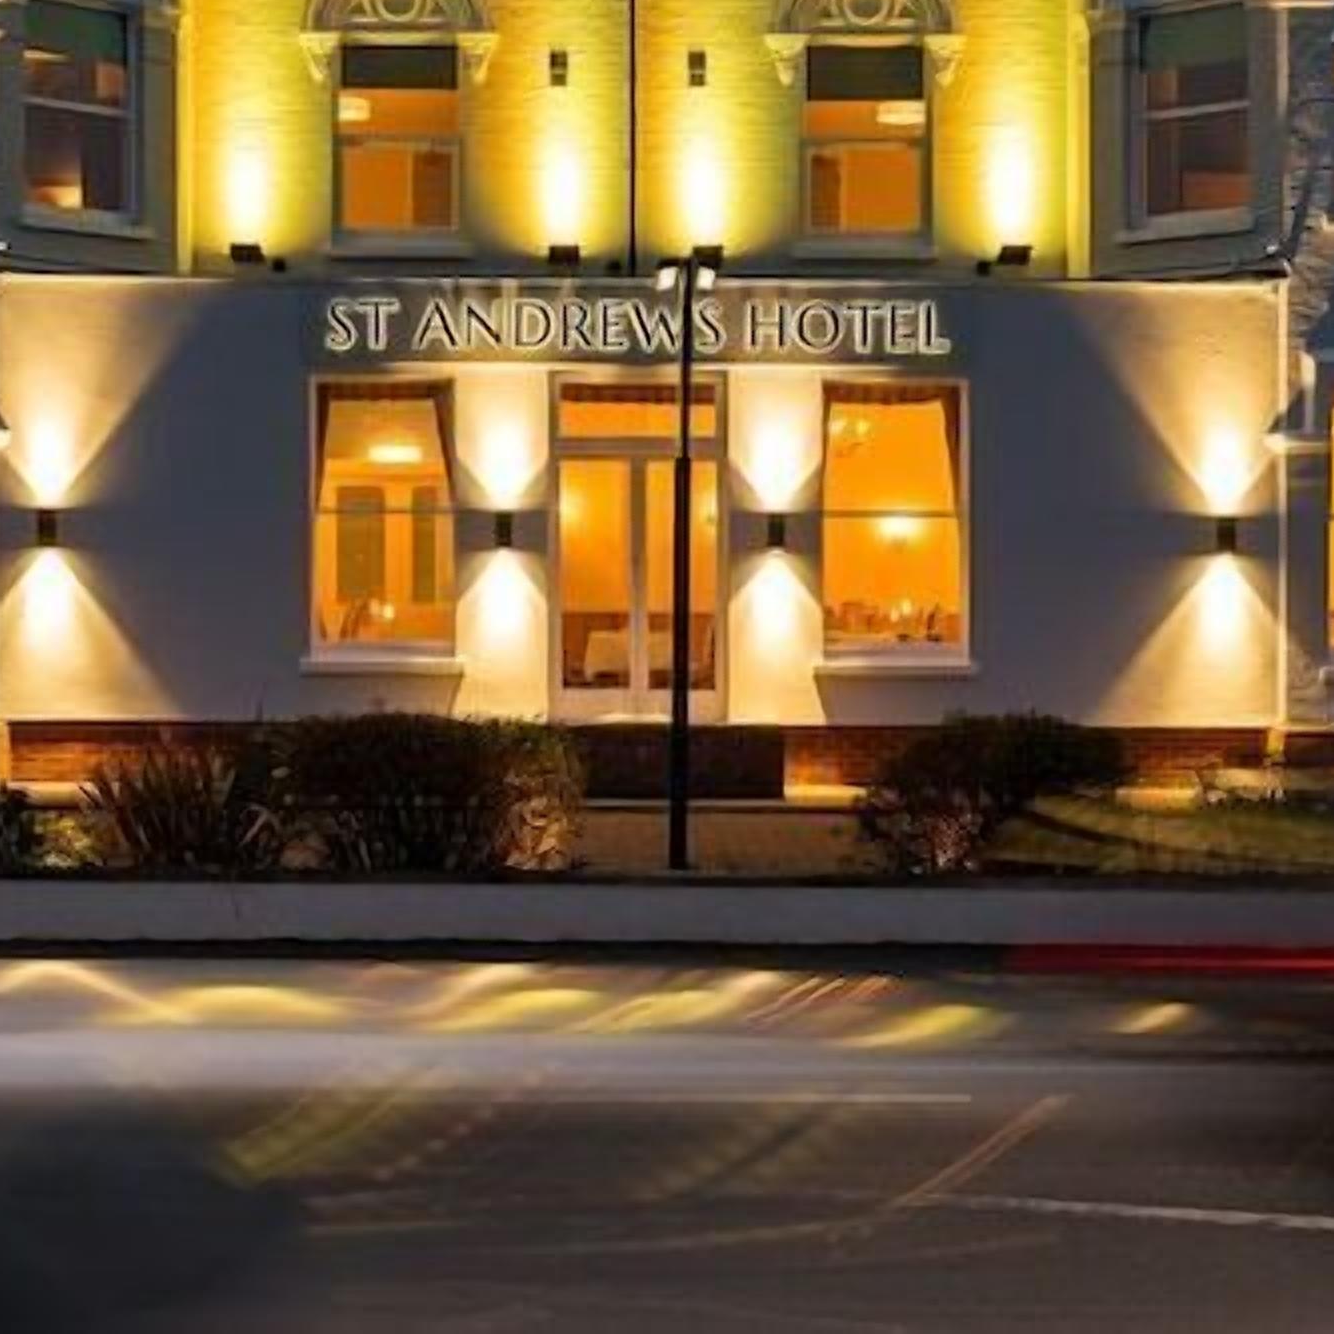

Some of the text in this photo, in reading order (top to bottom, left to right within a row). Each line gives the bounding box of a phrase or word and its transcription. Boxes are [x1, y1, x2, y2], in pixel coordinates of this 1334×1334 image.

[325, 296, 952, 354] ST ANDREWS HOTEL
